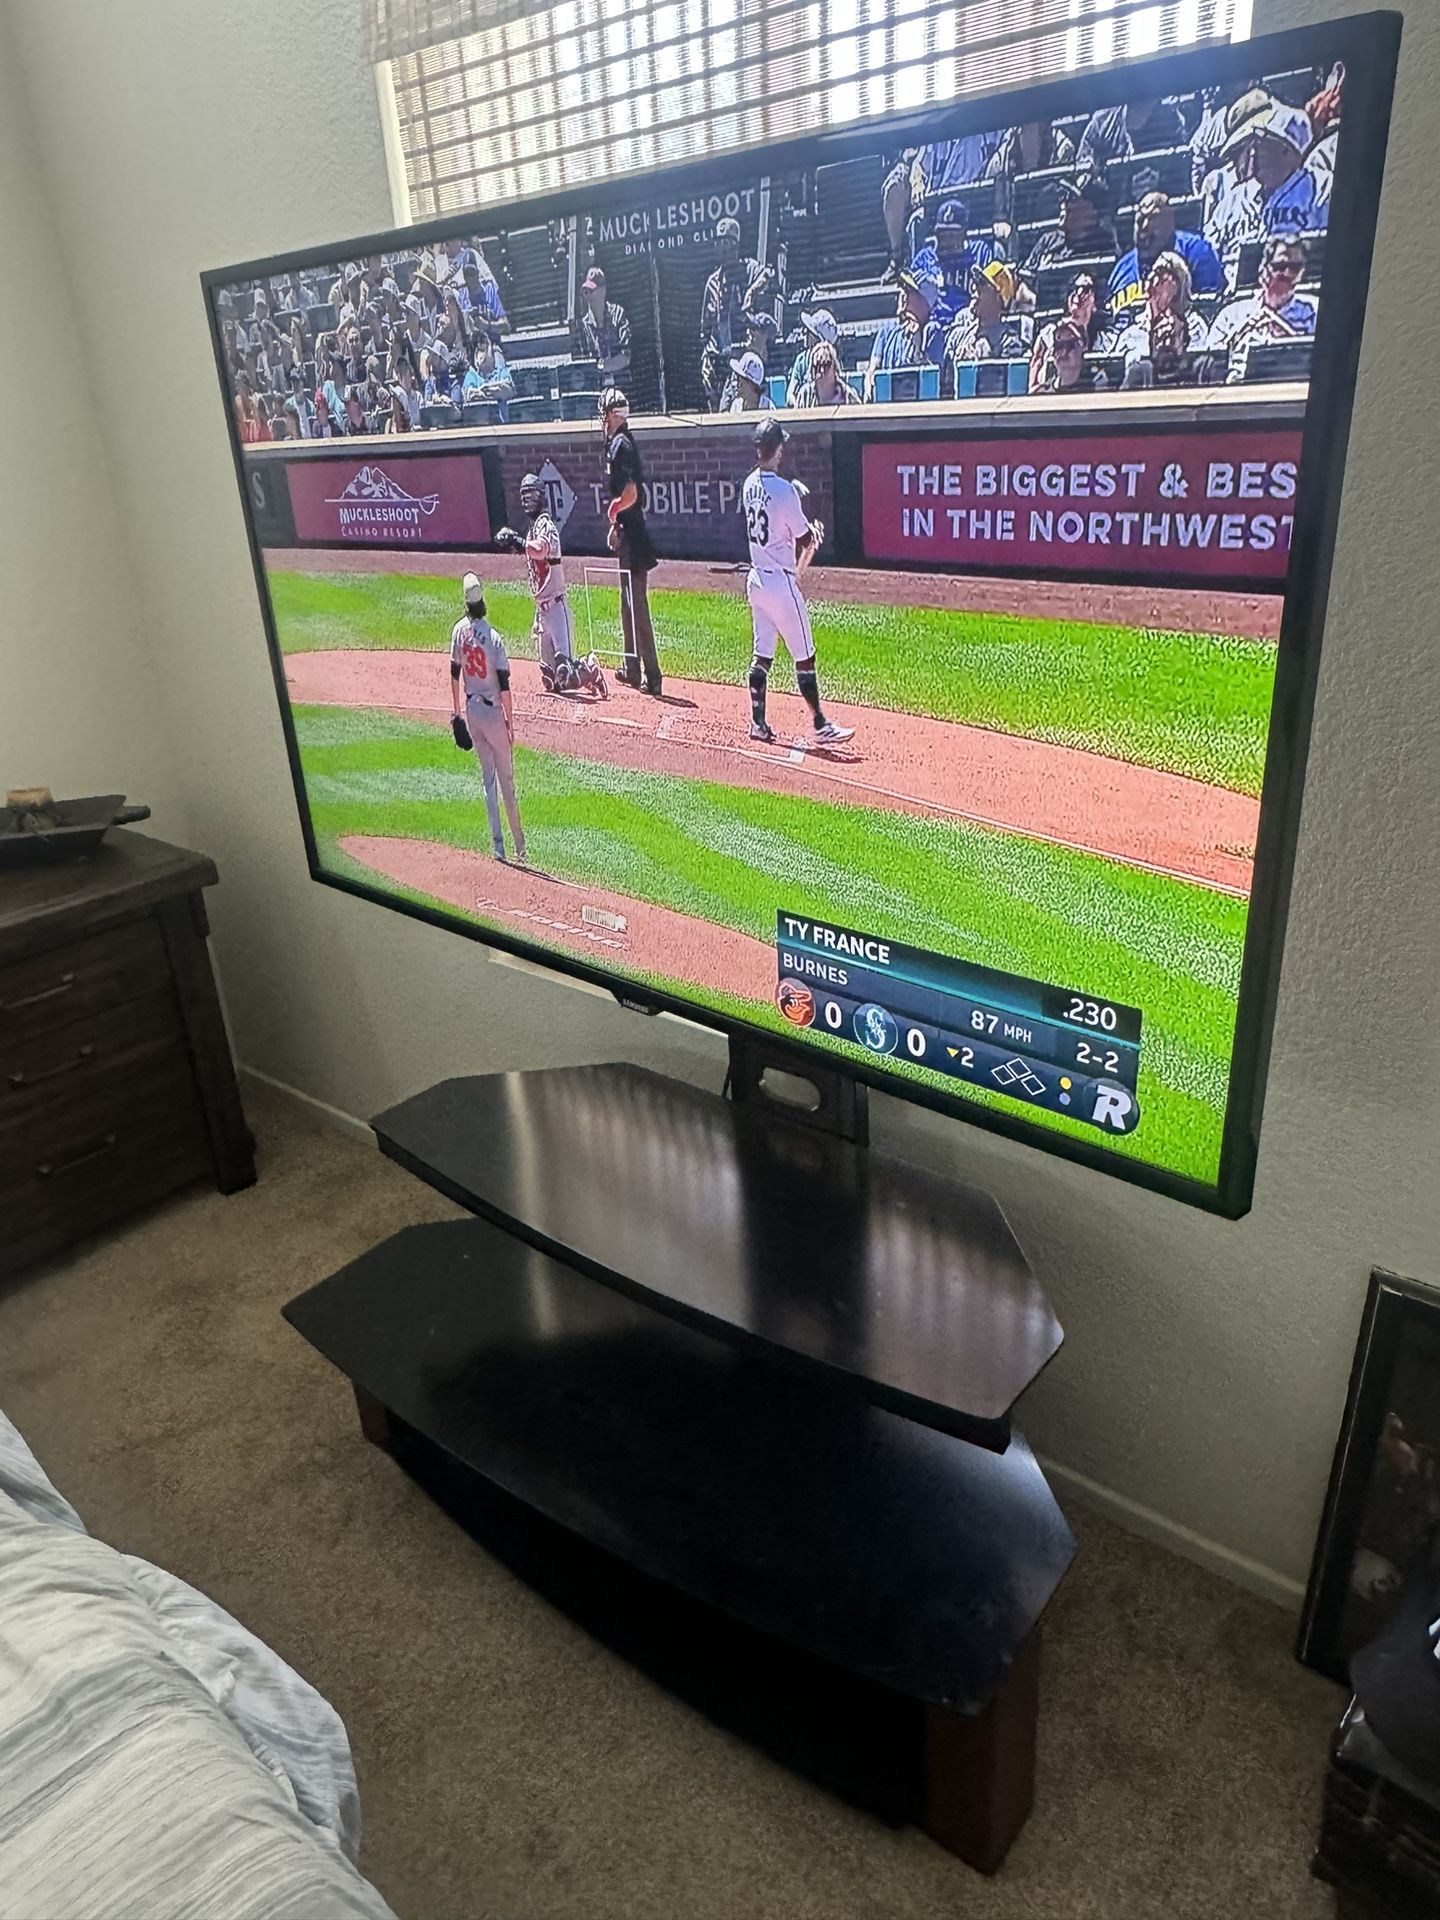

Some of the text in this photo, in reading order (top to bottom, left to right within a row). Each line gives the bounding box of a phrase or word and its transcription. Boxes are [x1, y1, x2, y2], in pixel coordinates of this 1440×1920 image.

[897, 463, 1297, 499] THE BIGGEST & BES
[339, 507, 419, 524] MUCKLESHOOT
[748, 506, 769, 547] 23
[903, 508, 1294, 550] IN THE NORTHWEST
[463, 644, 487, 679] 39
[785, 917, 890, 965] TY FRANCE
[783, 952, 848, 985] BURNES
[825, 1001, 843, 1029] 0
[971, 1010, 1032, 1043] 87 MPH
[1063, 998, 1117, 1031] .230
[906, 1029, 926, 1057] 0
[960, 1047, 975, 1068] 2
[1076, 1042, 1119, 1073] 2-2
